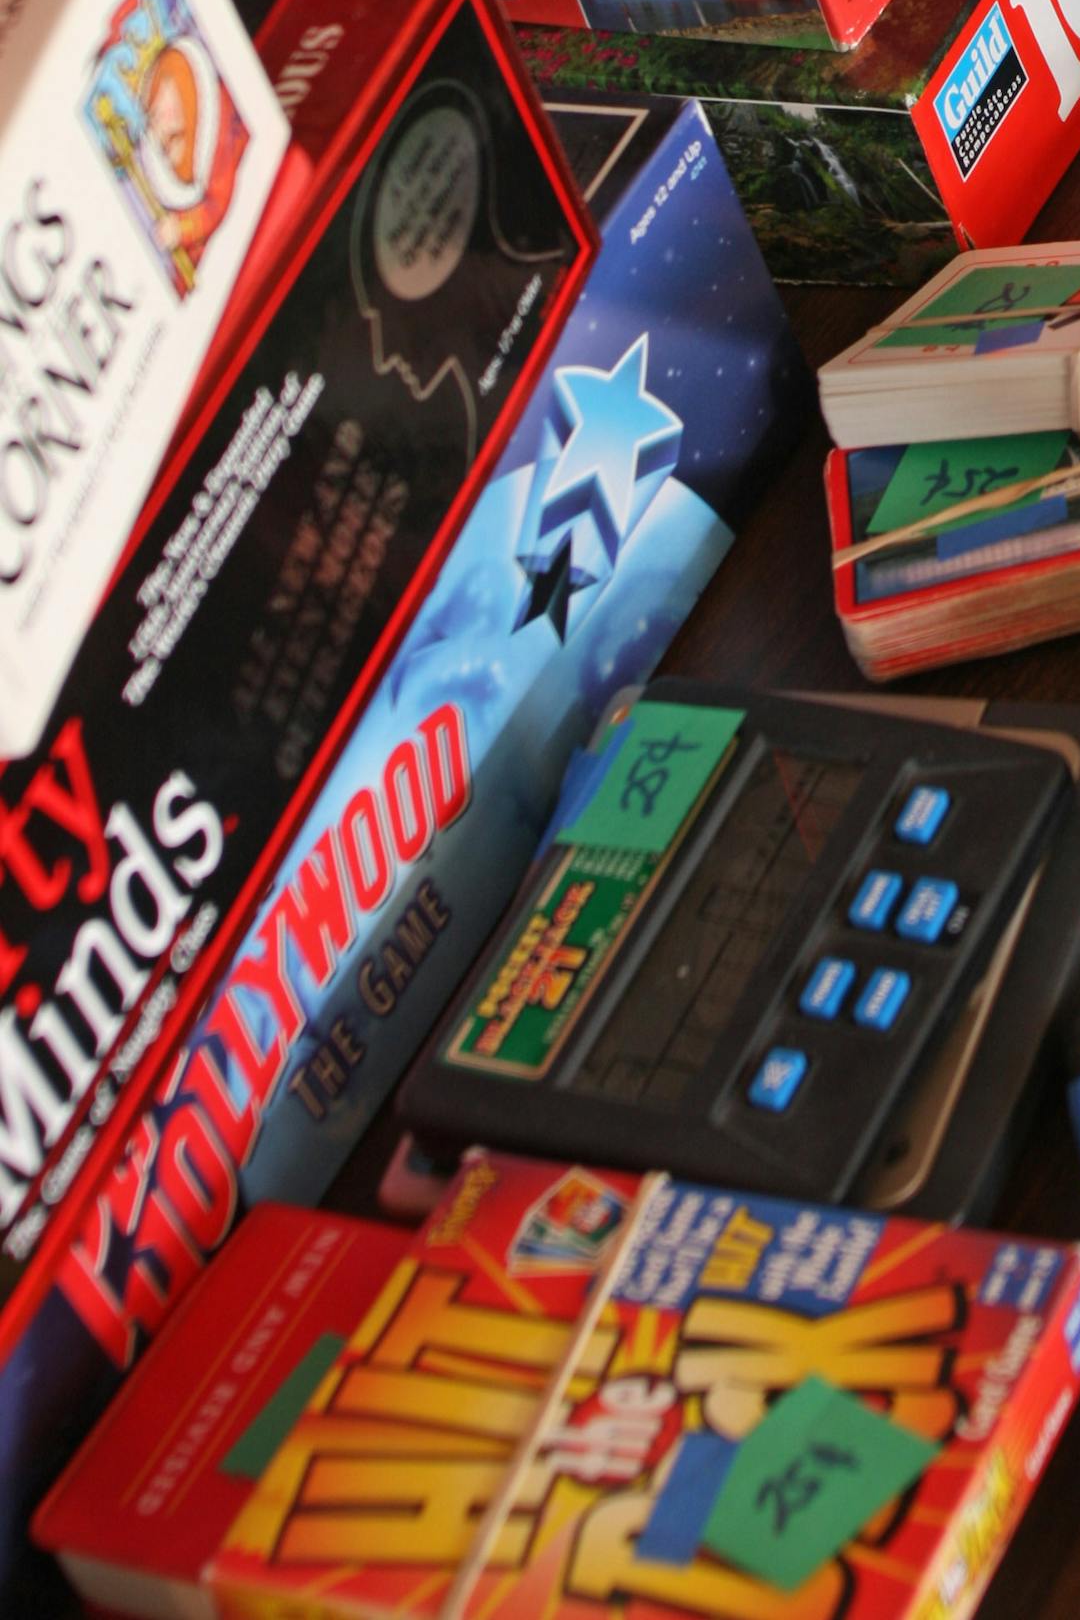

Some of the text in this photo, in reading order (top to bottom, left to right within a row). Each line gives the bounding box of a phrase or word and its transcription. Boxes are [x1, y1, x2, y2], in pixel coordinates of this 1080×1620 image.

[942, 12, 1011, 133] Guild
[954, 102, 983, 146] Puzzle
[959, 87, 1004, 155] Casse-tête
[962, 75, 1023, 168] Rompecabezas
[629, 137, 704, 247] Ages 12 and Up
[0, 769, 224, 1208] Minds
[55, 701, 470, 1370] HOLLYWOOD
[287, 882, 451, 1119] THE GAME
[526, 946, 589, 1010] 21
[137, 1227, 344, 1518] NEW AND REVISED
